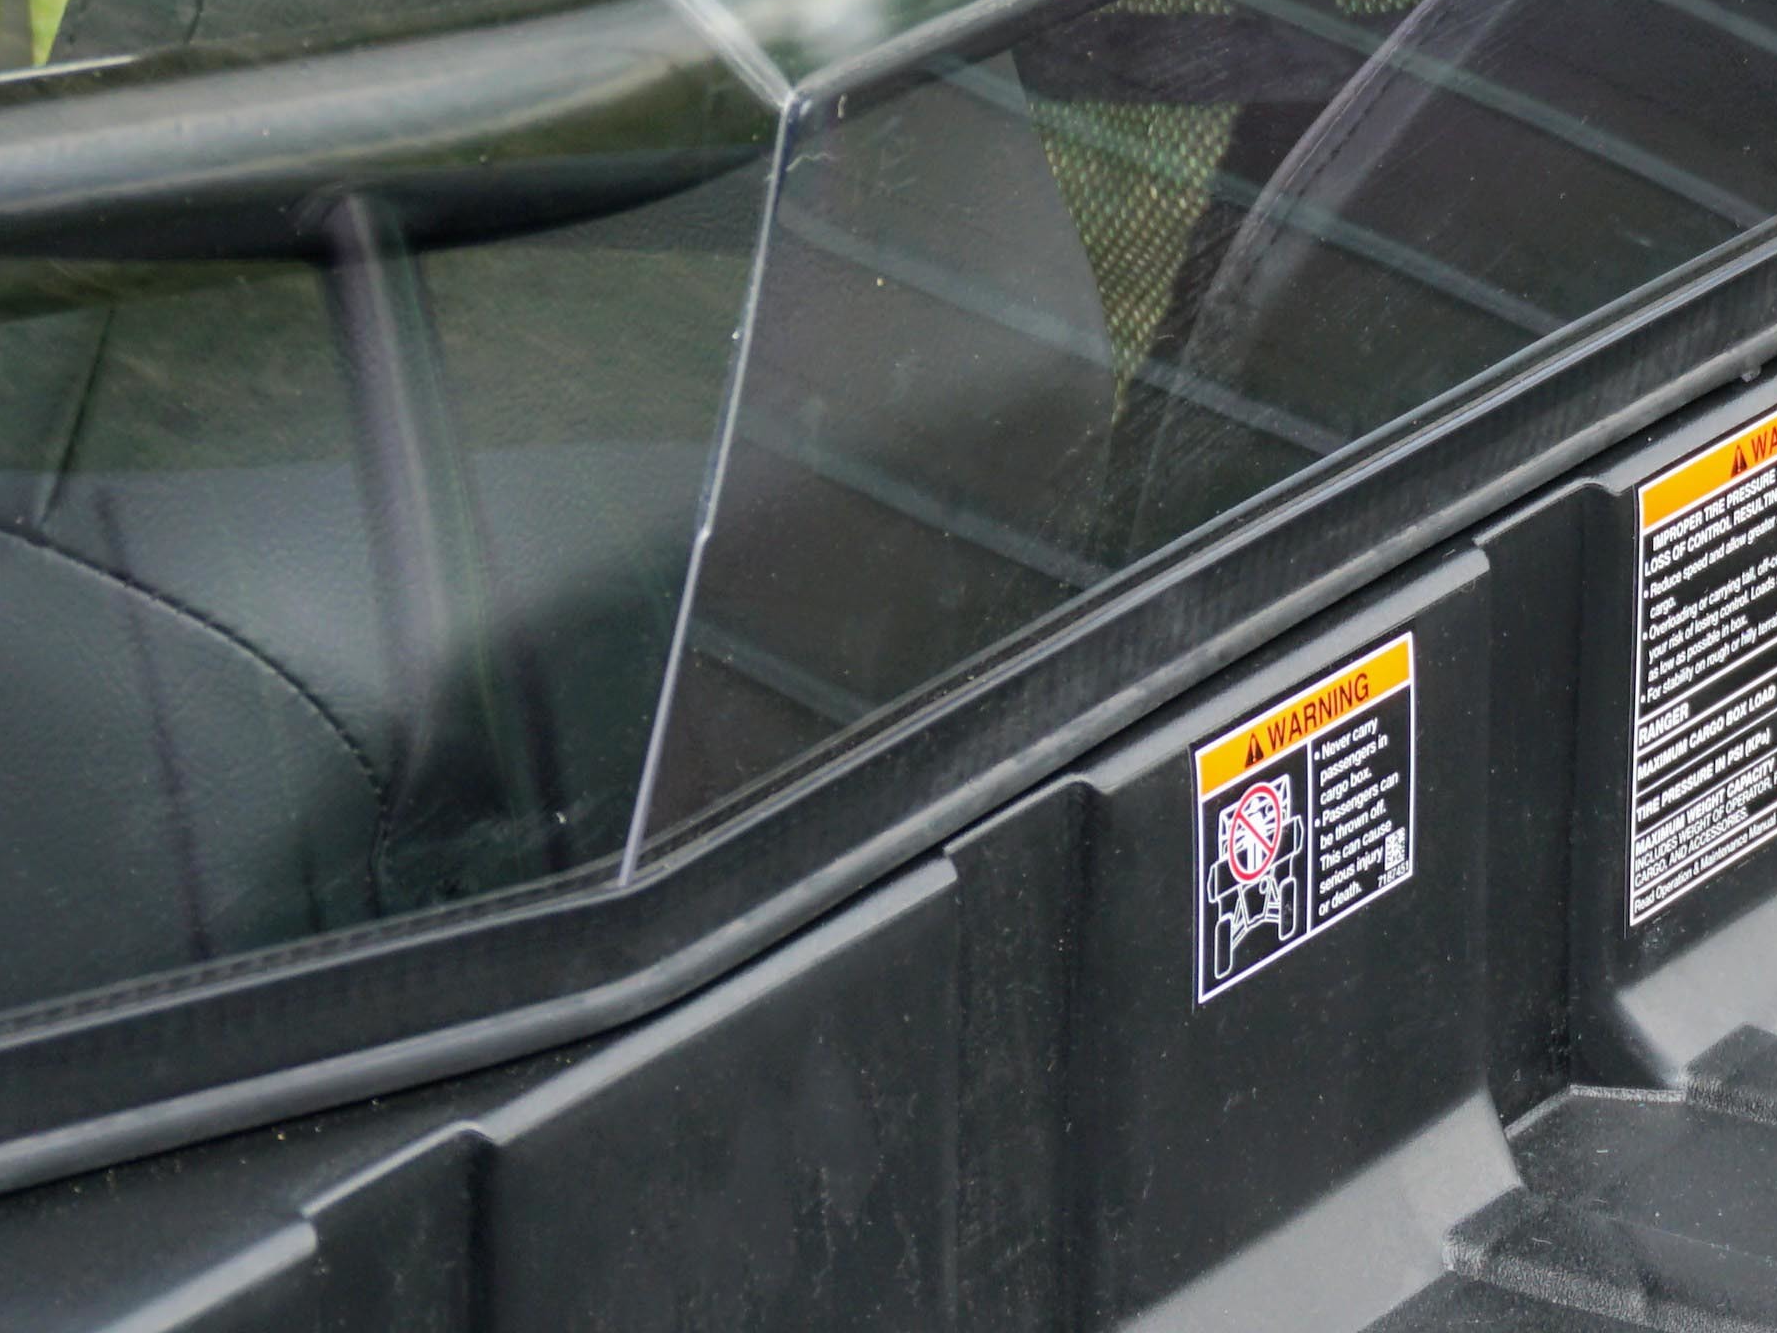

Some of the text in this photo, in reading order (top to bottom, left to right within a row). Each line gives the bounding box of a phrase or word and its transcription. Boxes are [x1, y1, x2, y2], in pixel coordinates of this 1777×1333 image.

[1652, 510, 1703, 550] IMPROPER
[1704, 497, 1725, 521] TIRE
[1726, 468, 1775, 508] PRESSURE
[1644, 549, 1671, 576] LOSS
[1671, 541, 1686, 560] OF
[1686, 514, 1732, 552] CONTROL
[1649, 568, 1682, 597] Reduce
[1682, 553, 1708, 582] speed
[1708, 543, 1724, 563] and
[1725, 530, 1746, 553] allow
[1747, 515, 1776, 544] greater
[1648, 600, 1697, 642] Overloading
[1698, 597, 1708, 610] or
[1708, 575, 1741, 607] carrying
[1648, 641, 1667, 664] your
[1668, 629, 1684, 648] risk
[1684, 623, 1694, 638] of
[1694, 608, 1719, 636] losing
[1719, 590, 1749, 617] control.
[1750, 575, 1775, 600] Loads
[1649, 595, 1676, 622] cargo.
[1646, 682, 1662, 702] For
[1661, 663, 1694, 696] stability
[1694, 659, 1706, 673] on
[1706, 642, 1730, 670] rough
[1730, 639, 1740, 651] or
[1740, 626, 1757, 649] hilly
[1647, 611, 1748, 682] as low as possible in box.
[1267, 672, 1369, 751] WARNING
[1321, 717, 1378, 760] Never carry
[1636, 683, 1776, 780] MAXIMUM CARGO BOX LOAD
[1637, 701, 1689, 746] RANGER
[1319, 732, 1387, 786] passengers in
[1320, 763, 1372, 807] cargo box.
[1635, 727, 1770, 822] TIRE PRESSURE IN PSI (KPa)
[1319, 799, 1386, 849] be thrown off.
[1322, 771, 1399, 828] Passengers can
[1634, 835, 1677, 871] INCLUDES
[1678, 814, 1711, 844] WEIGHT
[1711, 805, 1724, 822] OF
[1725, 775, 1773, 815] OPERATOR,
[1635, 757, 1775, 855] MAXIMUM WEIGHT CAPACITY
[1319, 818, 1392, 870] This can cause
[1633, 890, 1654, 912] Read
[1655, 866, 1692, 900] Operation
[1692, 861, 1699, 874] &
[1699, 830, 1748, 870] Maintenance
[1748, 813, 1776, 839] Manual
[1668, 844, 1687, 865] AND
[1687, 805, 1749, 852] ACCESSORIES.
[1318, 879, 1361, 915] or death.
[1319, 844, 1383, 894] serious injury
